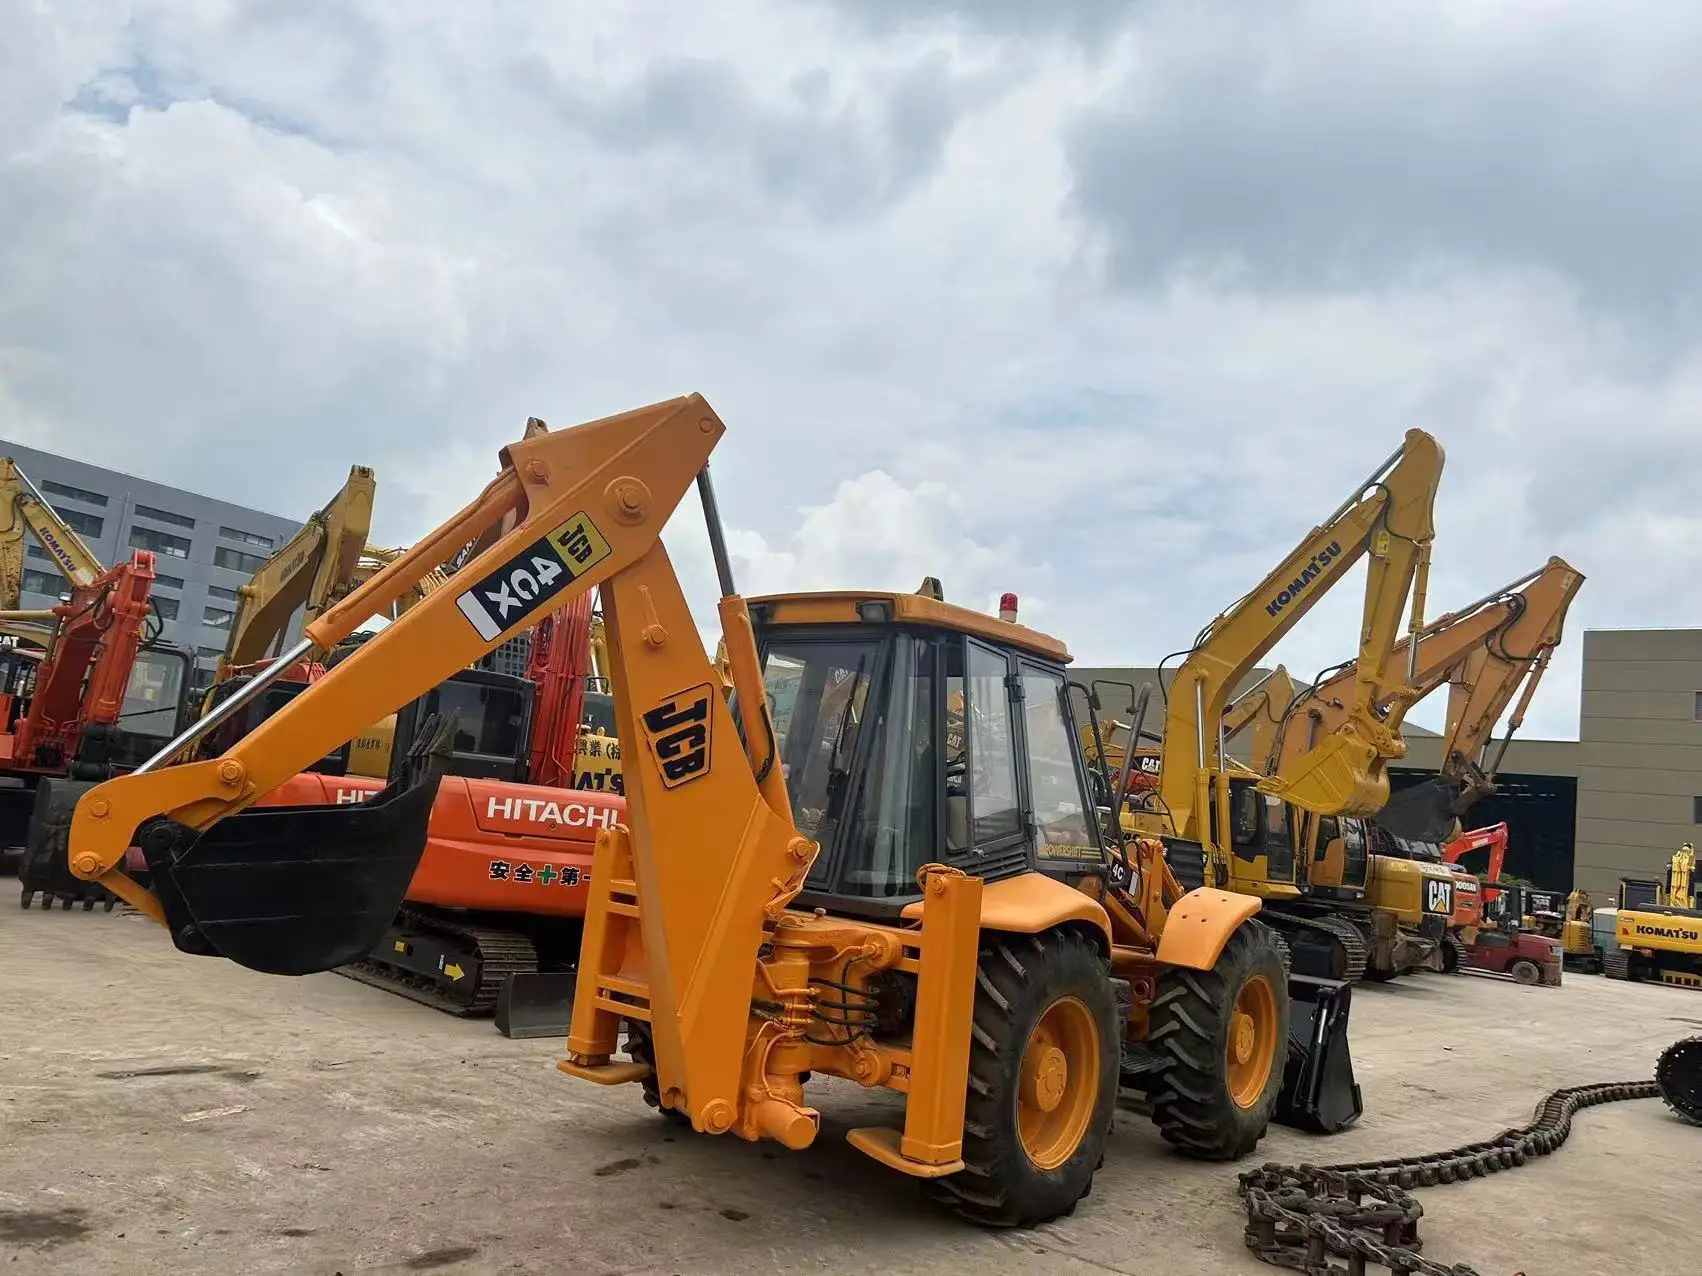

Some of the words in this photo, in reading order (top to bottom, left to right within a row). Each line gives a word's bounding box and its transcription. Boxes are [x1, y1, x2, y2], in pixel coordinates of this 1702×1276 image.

[40, 527, 77, 571] KOMATSU
[557, 523, 592, 564] JCB
[1265, 541, 1341, 618] KOMATSU
[643, 698, 707, 780] JCB
[1141, 757, 1160, 774] CAT
[487, 796, 618, 830] HITACHI
[1428, 880, 1452, 913] CAT
[1636, 925, 1698, 940] KOMATSU
